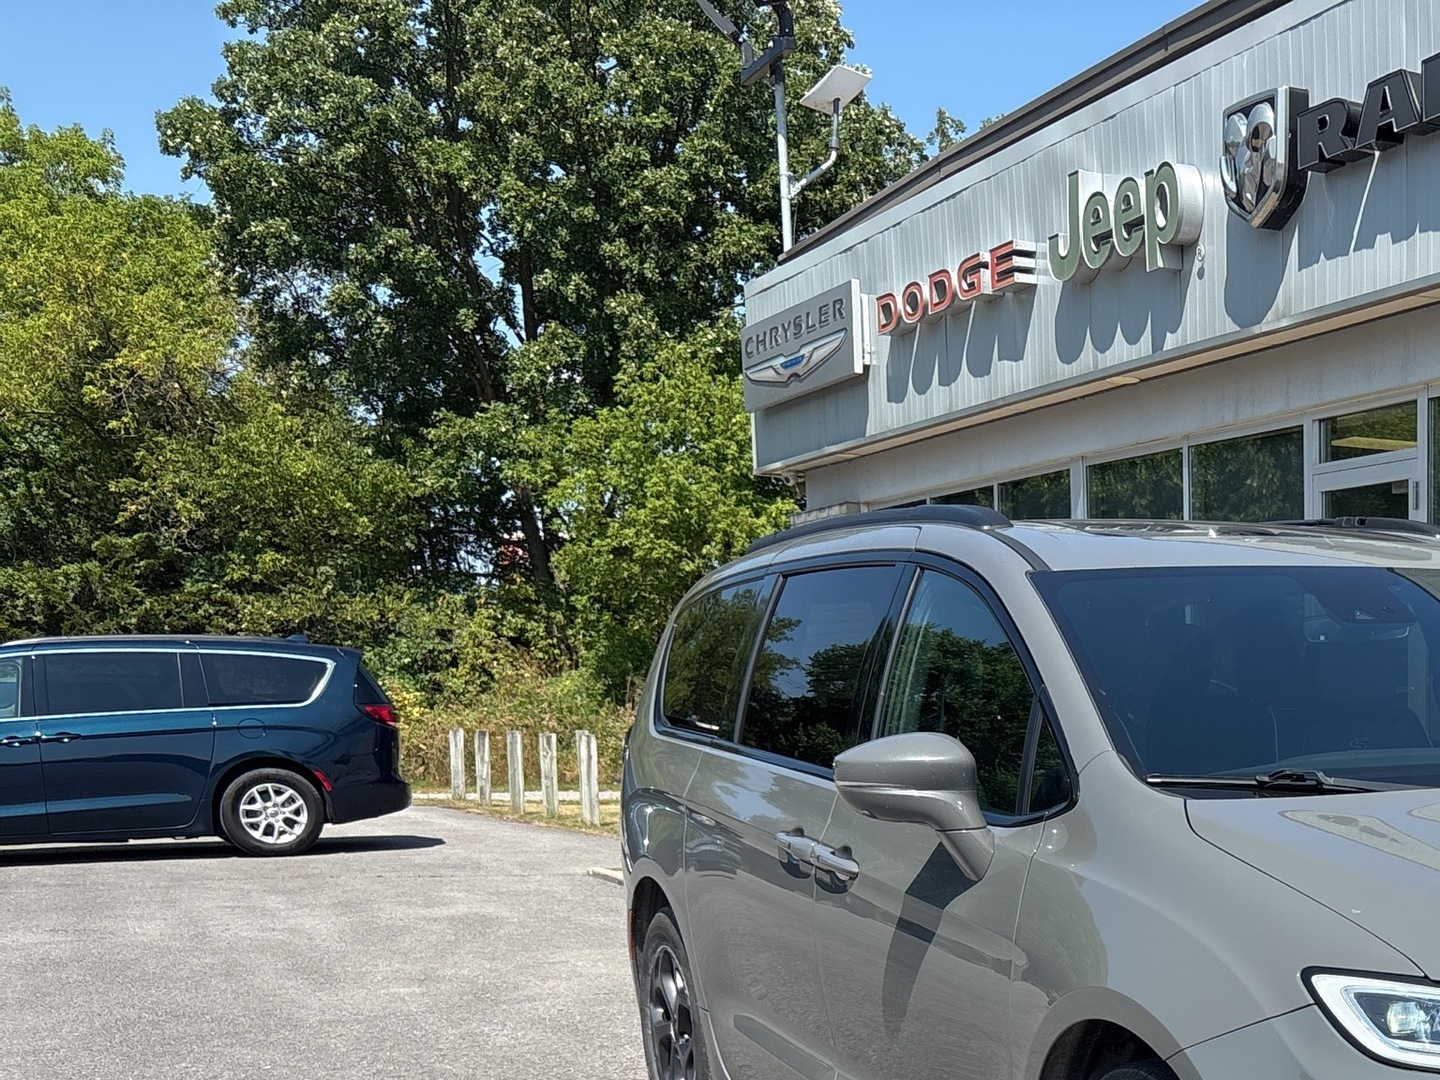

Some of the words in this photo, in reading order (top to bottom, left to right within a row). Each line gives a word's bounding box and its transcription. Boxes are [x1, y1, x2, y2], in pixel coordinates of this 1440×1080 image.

[1047, 161, 1181, 282] Jeep
[744, 298, 845, 360] CHRYSLER
[876, 240, 1016, 335] DODGE
